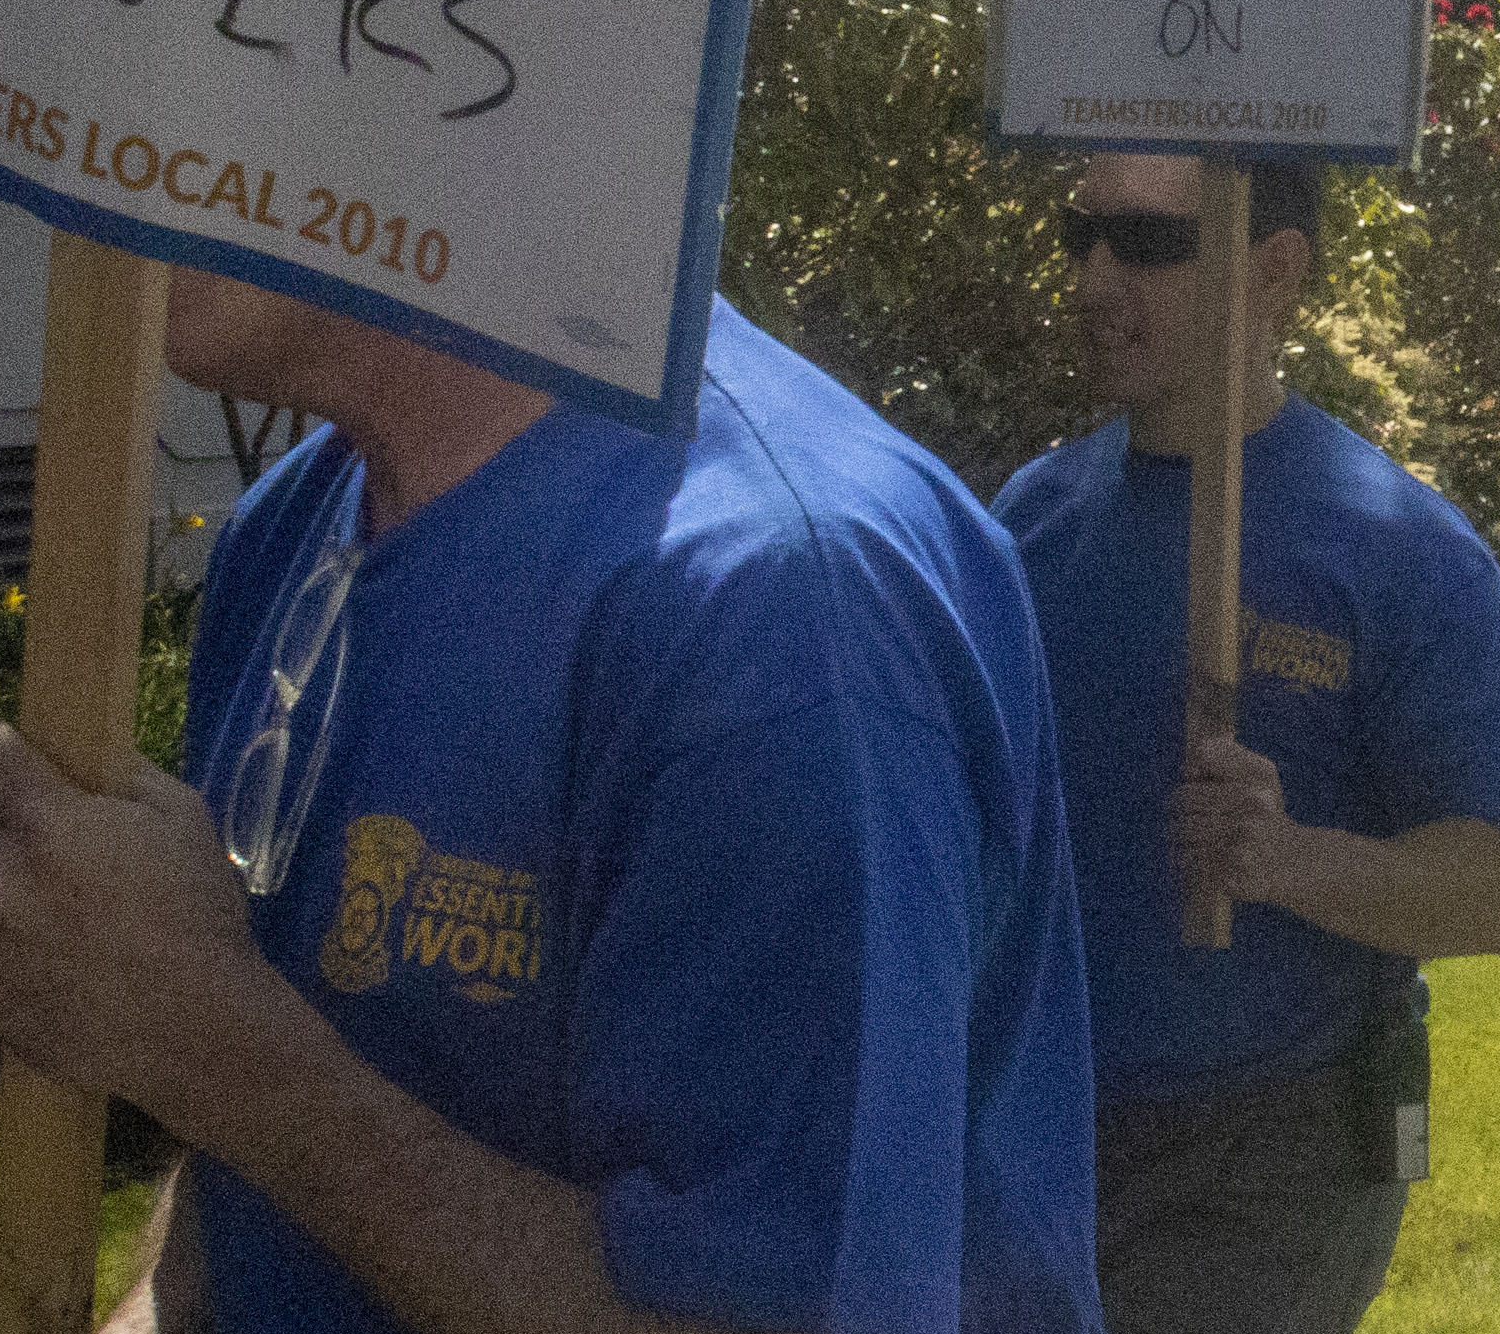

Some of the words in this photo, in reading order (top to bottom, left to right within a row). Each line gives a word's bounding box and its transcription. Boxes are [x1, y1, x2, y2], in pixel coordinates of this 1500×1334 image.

[1060, 96, 1189, 129] TEAMSTERS
[1193, 99, 1265, 129] LOCAL
[1271, 99, 1328, 131] 2010
[80, 118, 283, 233] LOCAL
[298, 186, 453, 284] 2010
